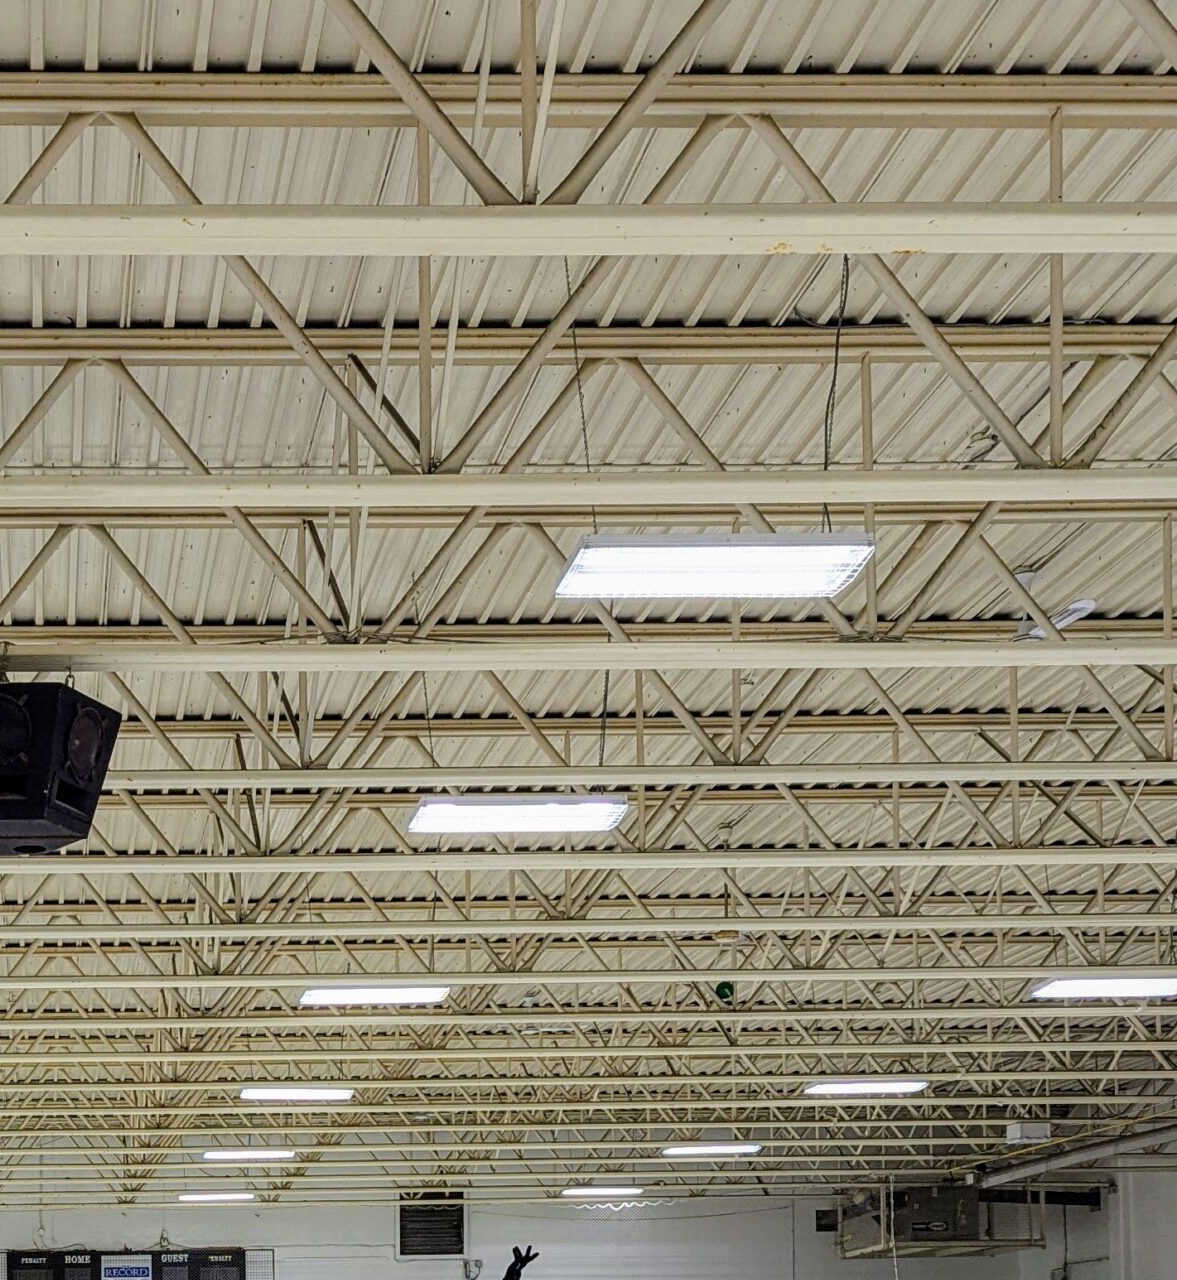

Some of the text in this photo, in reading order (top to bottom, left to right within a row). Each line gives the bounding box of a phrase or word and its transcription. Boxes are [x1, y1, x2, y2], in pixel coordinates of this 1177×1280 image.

[64, 1255, 91, 1264] HOME
[161, 1253, 189, 1262] GUEST
[105, 1268, 149, 1277] RECORD
